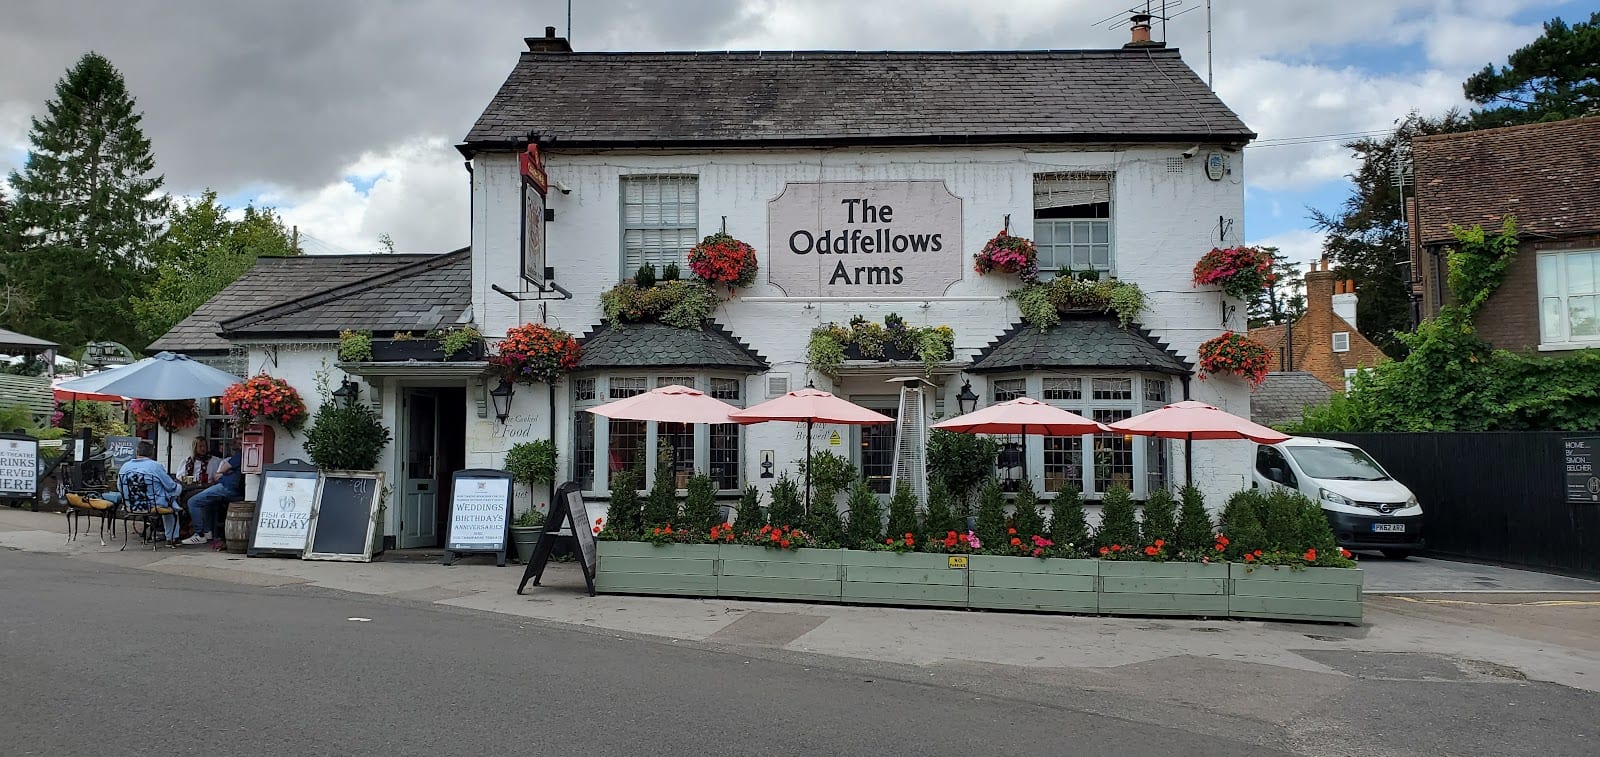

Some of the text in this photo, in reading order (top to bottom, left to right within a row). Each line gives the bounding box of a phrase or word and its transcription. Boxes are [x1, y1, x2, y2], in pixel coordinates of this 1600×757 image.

[841, 199, 893, 223] The
[789, 229, 942, 255] Oddfellows
[828, 259, 904, 285] Arms
[503, 423, 532, 438] Food
[1565, 441, 1585, 449] HOME
[7, 451, 35, 459] THEATRE
[0, 458, 35, 468] RINKS
[1566, 464, 1592, 472] BELCHER
[0, 468, 34, 478] ERVED
[456, 503, 504, 511] WEDDINGS
[261, 511, 279, 519] FISH
[289, 512, 308, 520] FIZZ
[455, 514, 504, 522] BIRTHDAYS
[260, 519, 309, 529] FRIDAY
